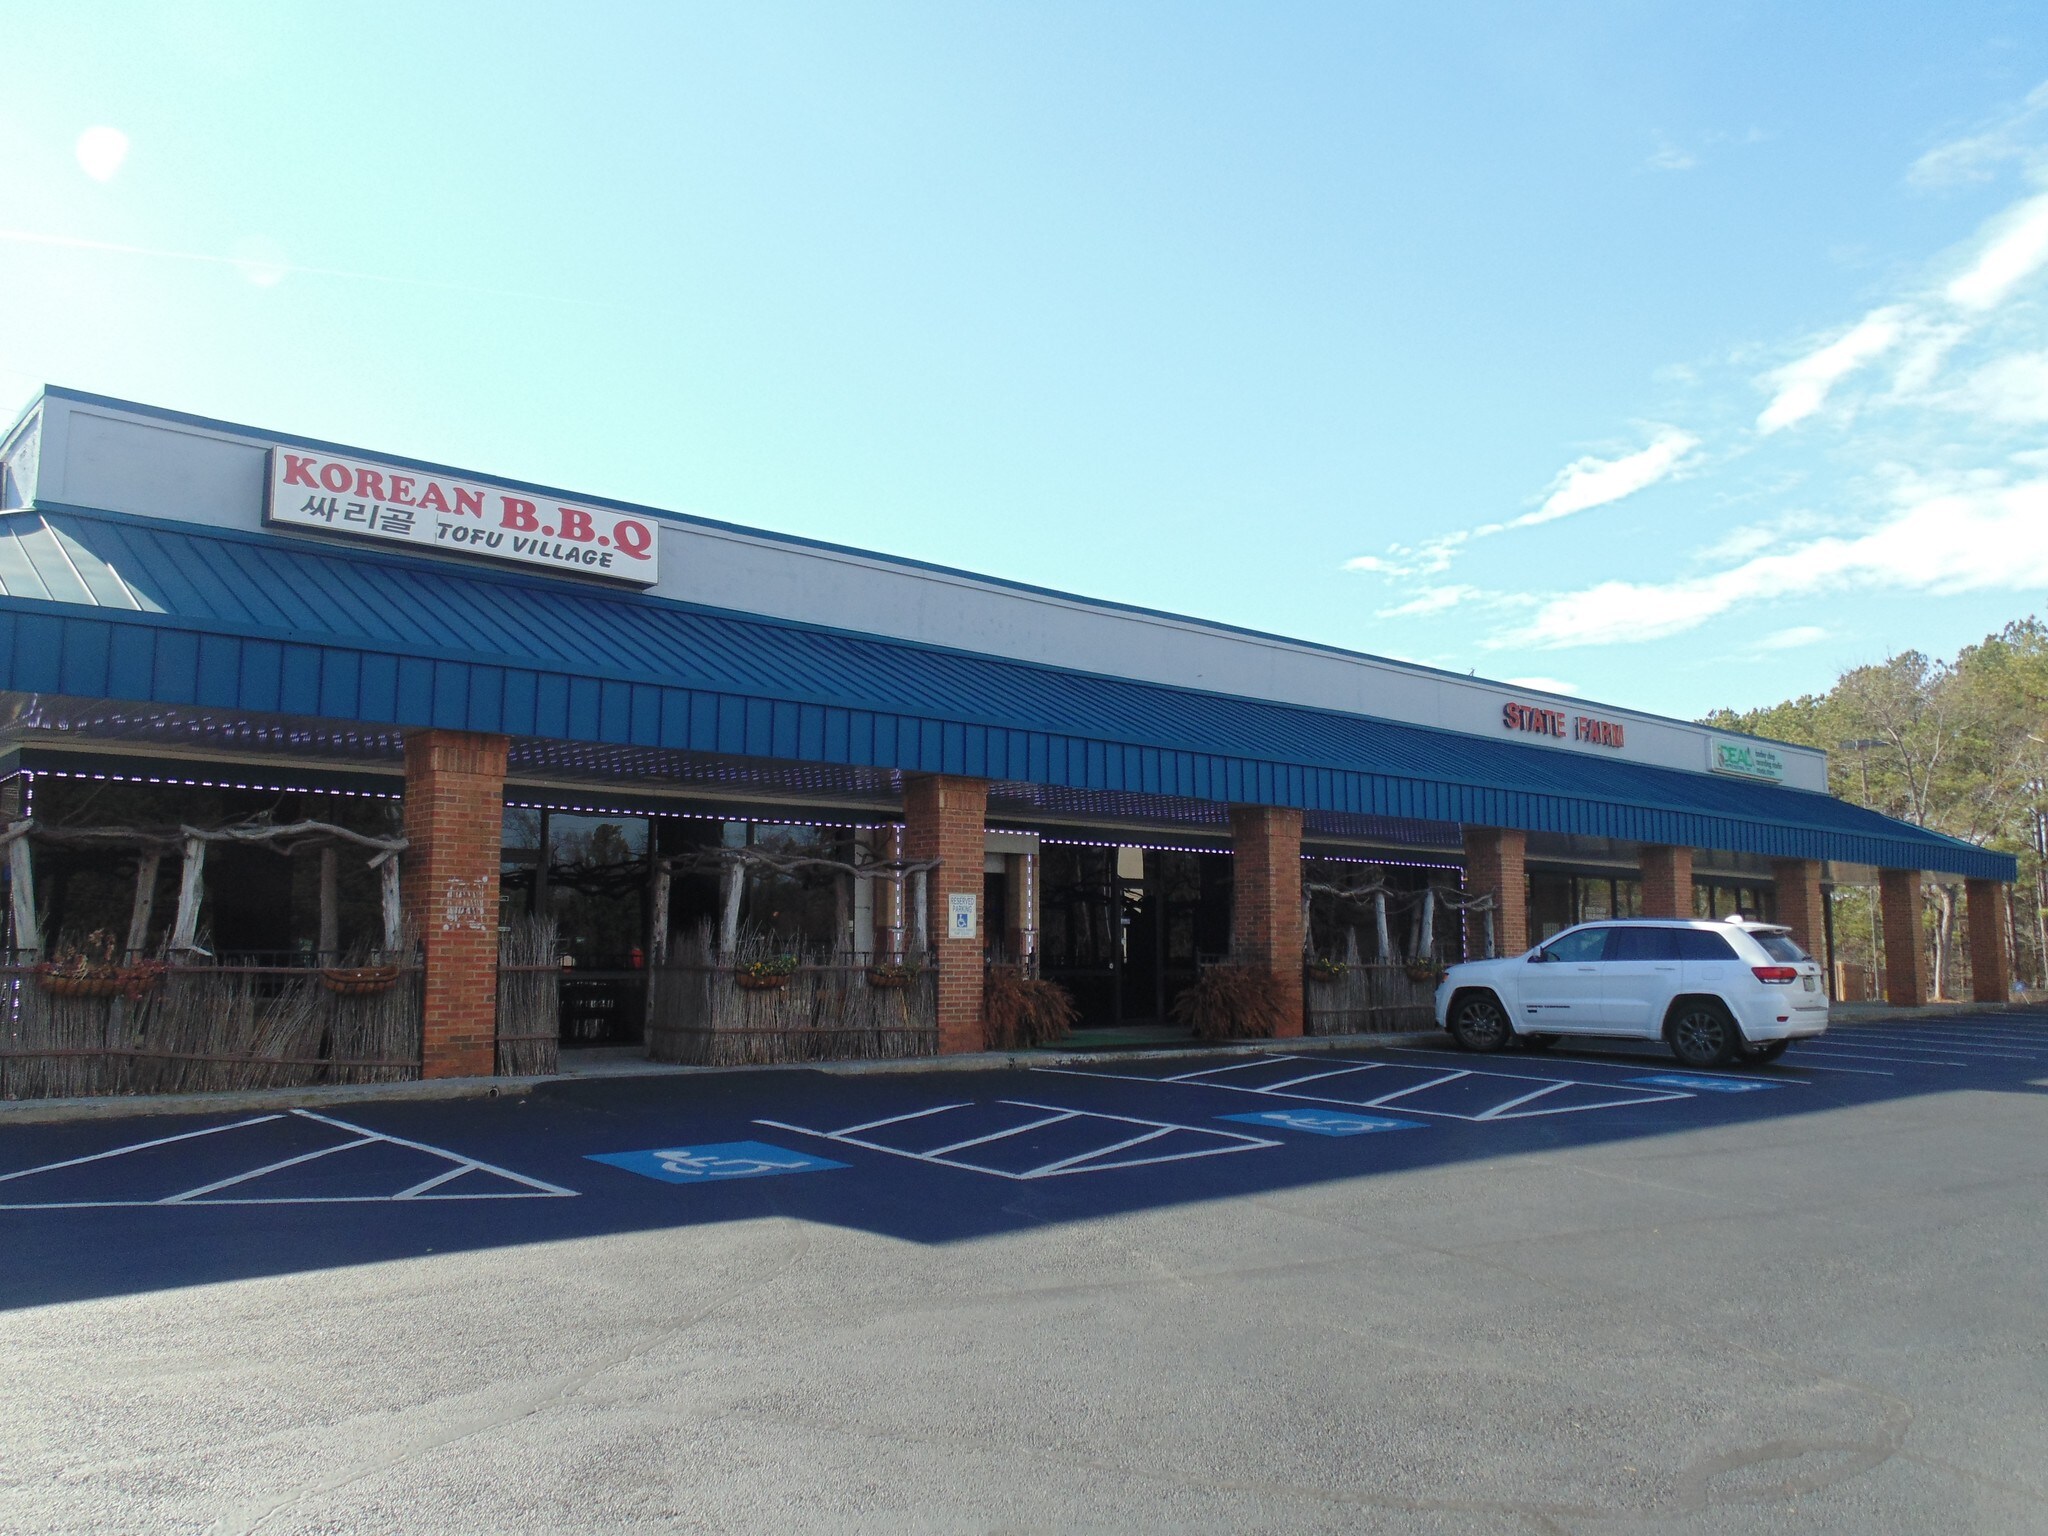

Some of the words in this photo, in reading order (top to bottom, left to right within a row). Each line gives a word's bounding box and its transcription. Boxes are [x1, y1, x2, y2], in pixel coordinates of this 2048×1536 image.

[283, 454, 485, 518] KOREAN
[499, 496, 652, 560] B.B.Q
[300, 495, 416, 535] 싸리골
[437, 522, 504, 548] TOFU
[513, 535, 614, 568] VILLAGE
[1503, 702, 1566, 737] STATE
[1575, 716, 1624, 748] FARM
[951, 896, 974, 905] RESERVED
[953, 905, 973, 913] PARKING
